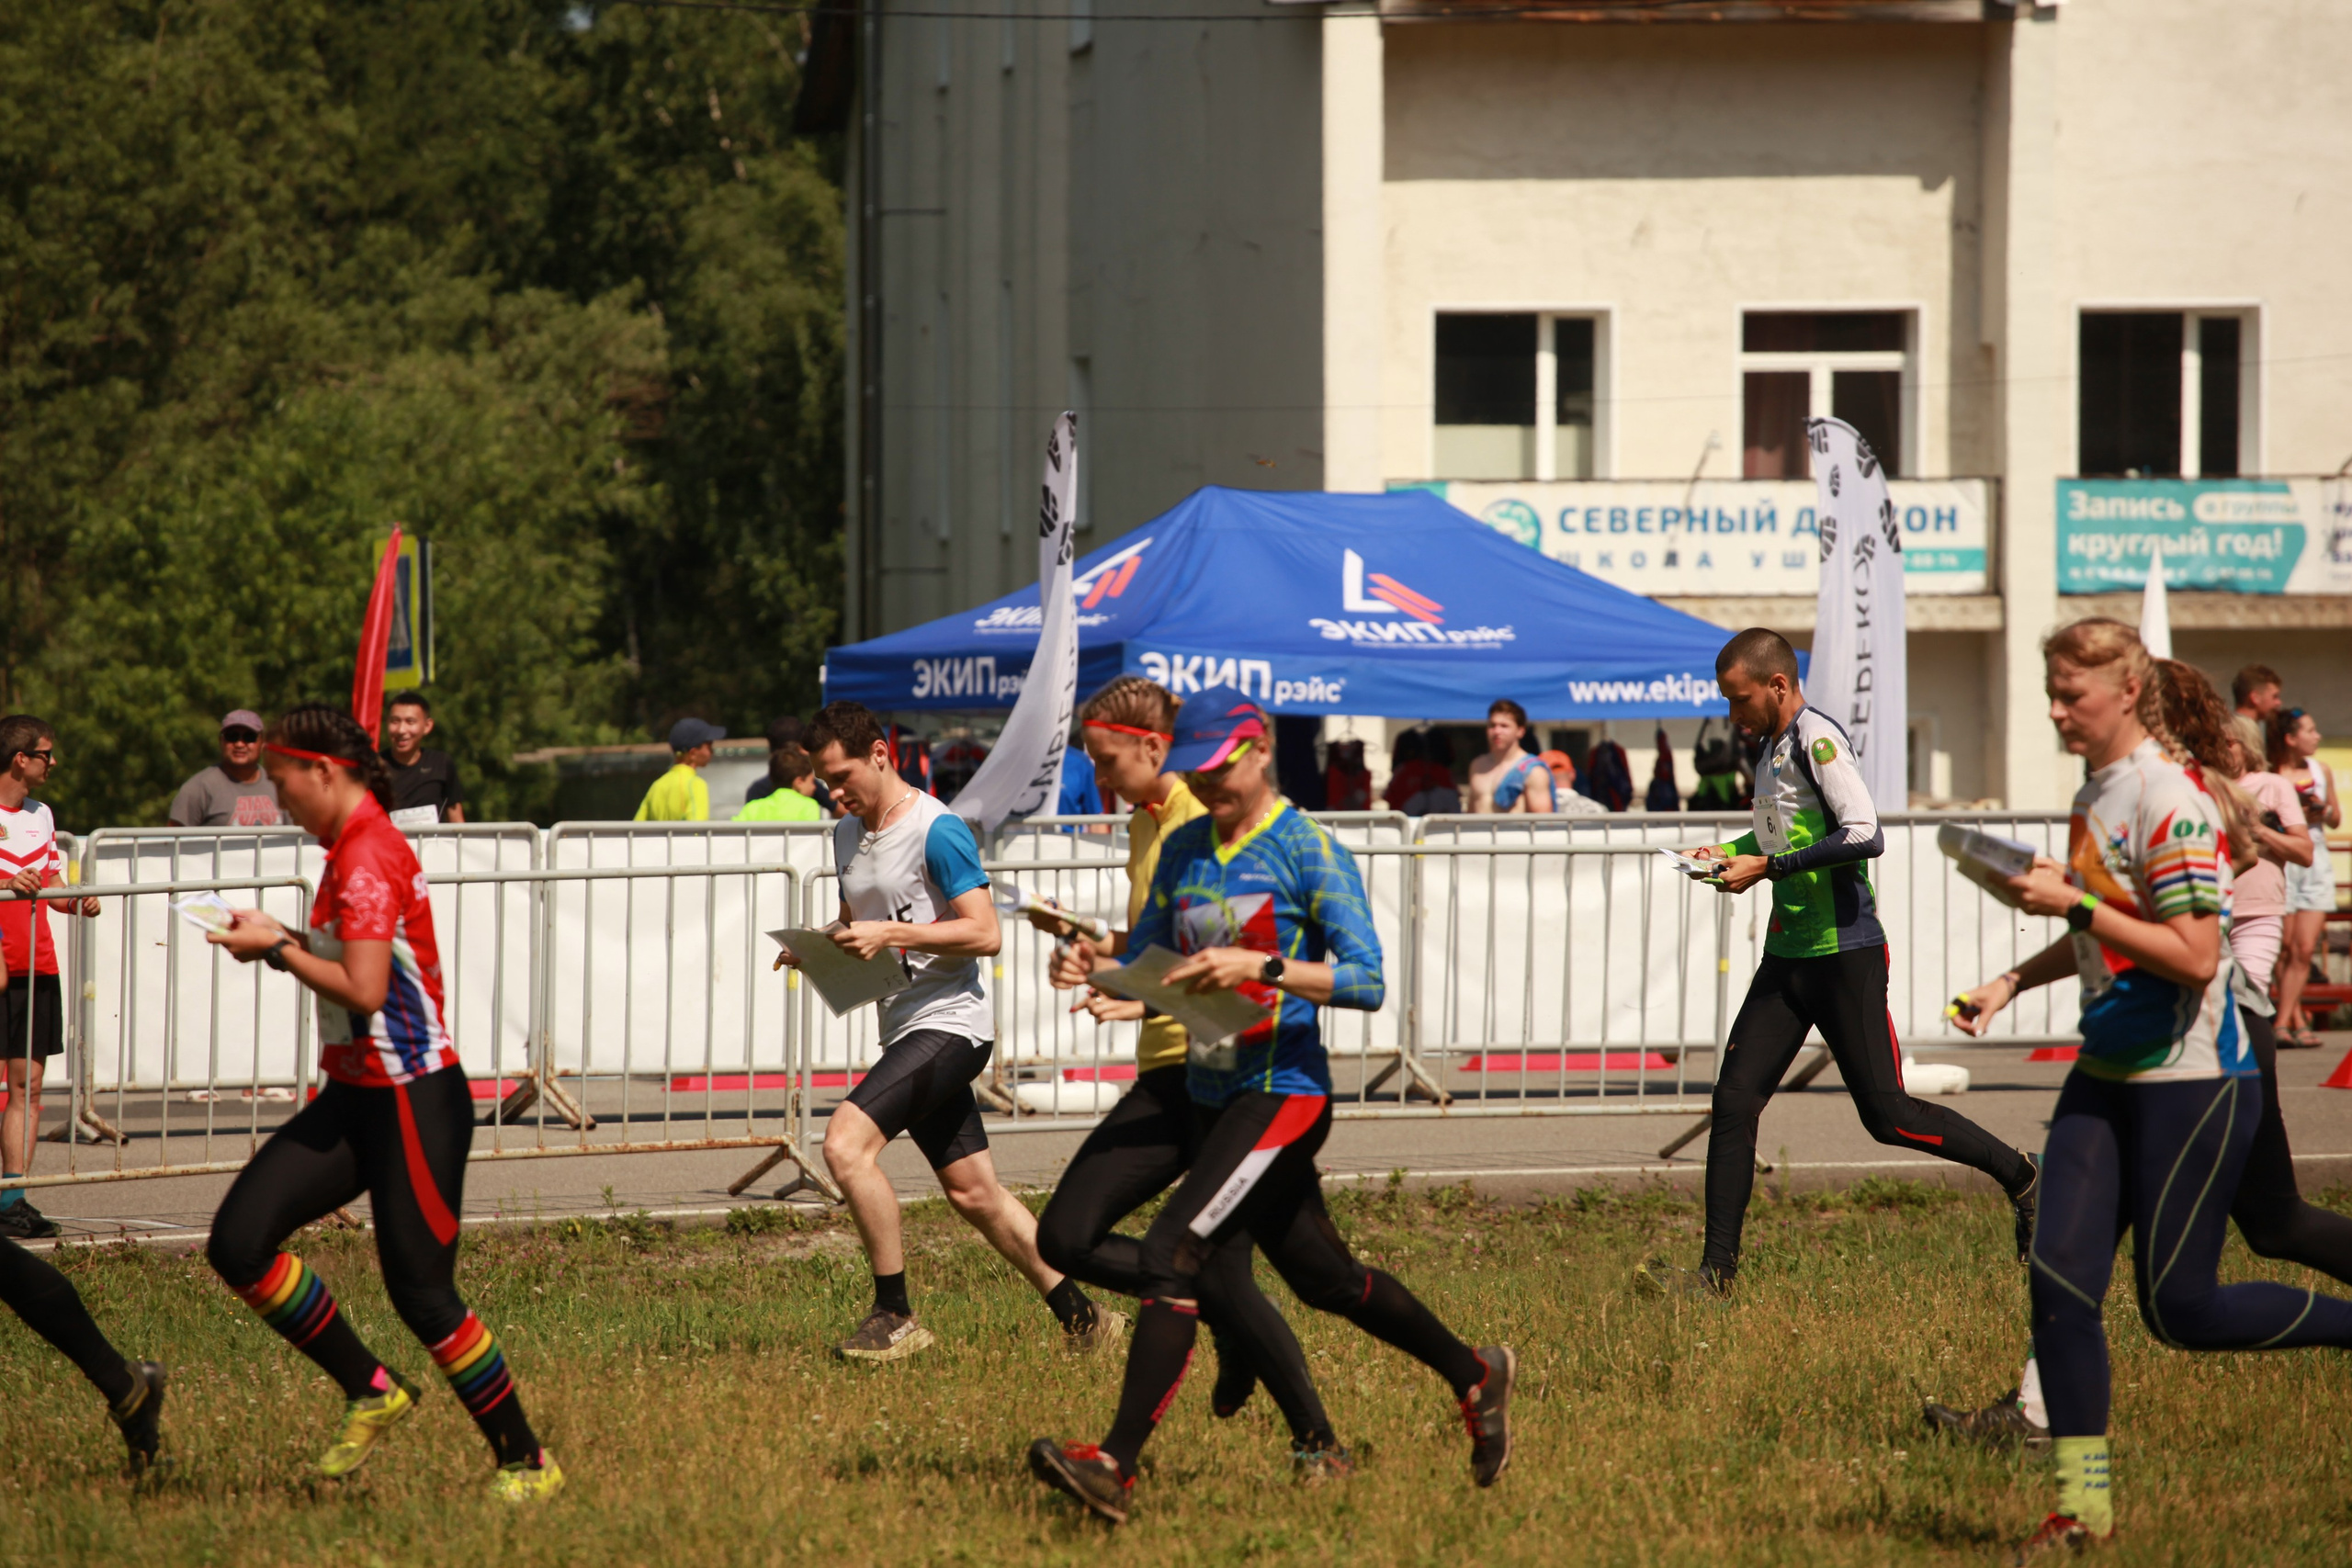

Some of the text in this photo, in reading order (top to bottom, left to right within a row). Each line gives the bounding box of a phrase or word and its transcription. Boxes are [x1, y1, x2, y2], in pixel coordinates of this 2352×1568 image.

[1558, 499, 1776, 534] СЕВЕРНЫЙ
[2067, 491, 2186, 520] Запись
[1750, 551, 1807, 569] УШ
[2068, 526, 2283, 561] круглый год!
[1568, 672, 1730, 707] www.ekipr
